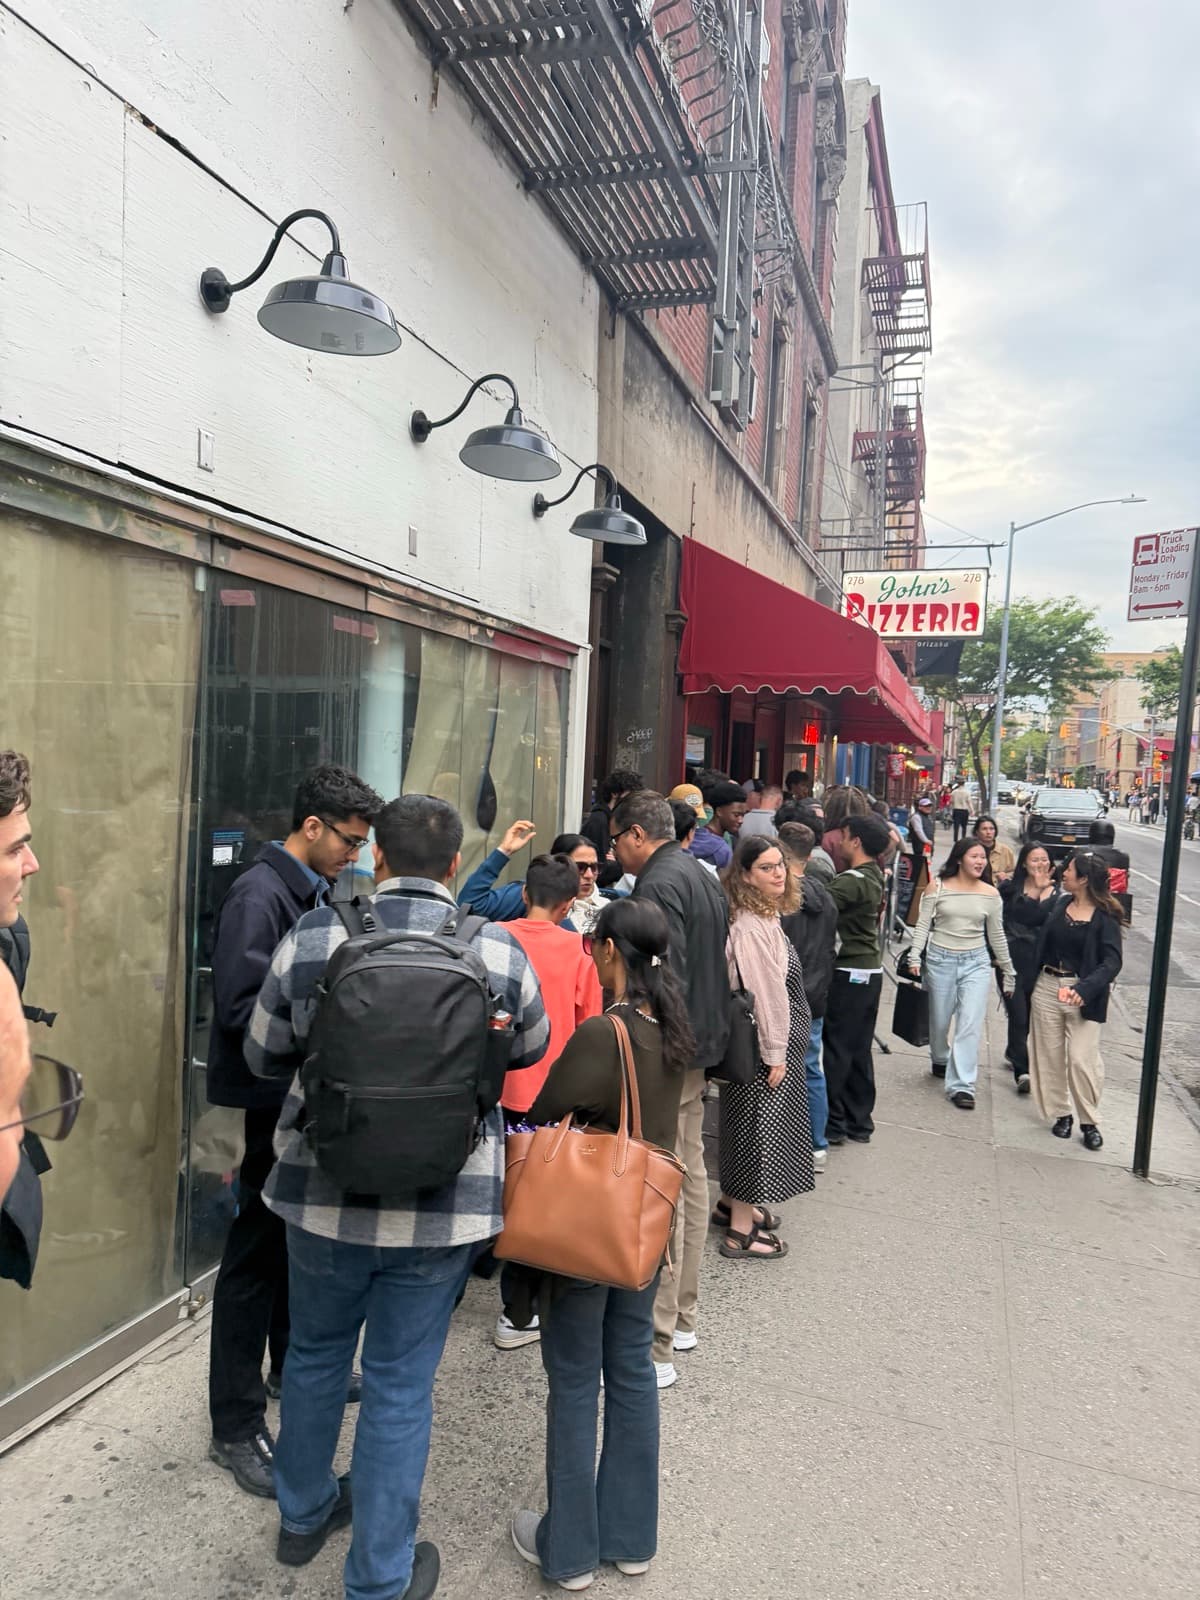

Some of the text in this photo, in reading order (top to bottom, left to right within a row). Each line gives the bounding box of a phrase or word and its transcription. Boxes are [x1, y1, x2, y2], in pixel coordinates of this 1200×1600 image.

[1162, 535, 1183, 544] Truck
[1161, 543, 1190, 554] Loading
[1160, 554, 1176, 563] Only
[847, 576, 865, 585] 278
[963, 573, 981, 583] 278
[1134, 574, 1159, 583] Monday
[1166, 570, 1189, 580] Friday
[877, 575, 956, 603] John's
[1154, 583, 1170, 592] 6pm
